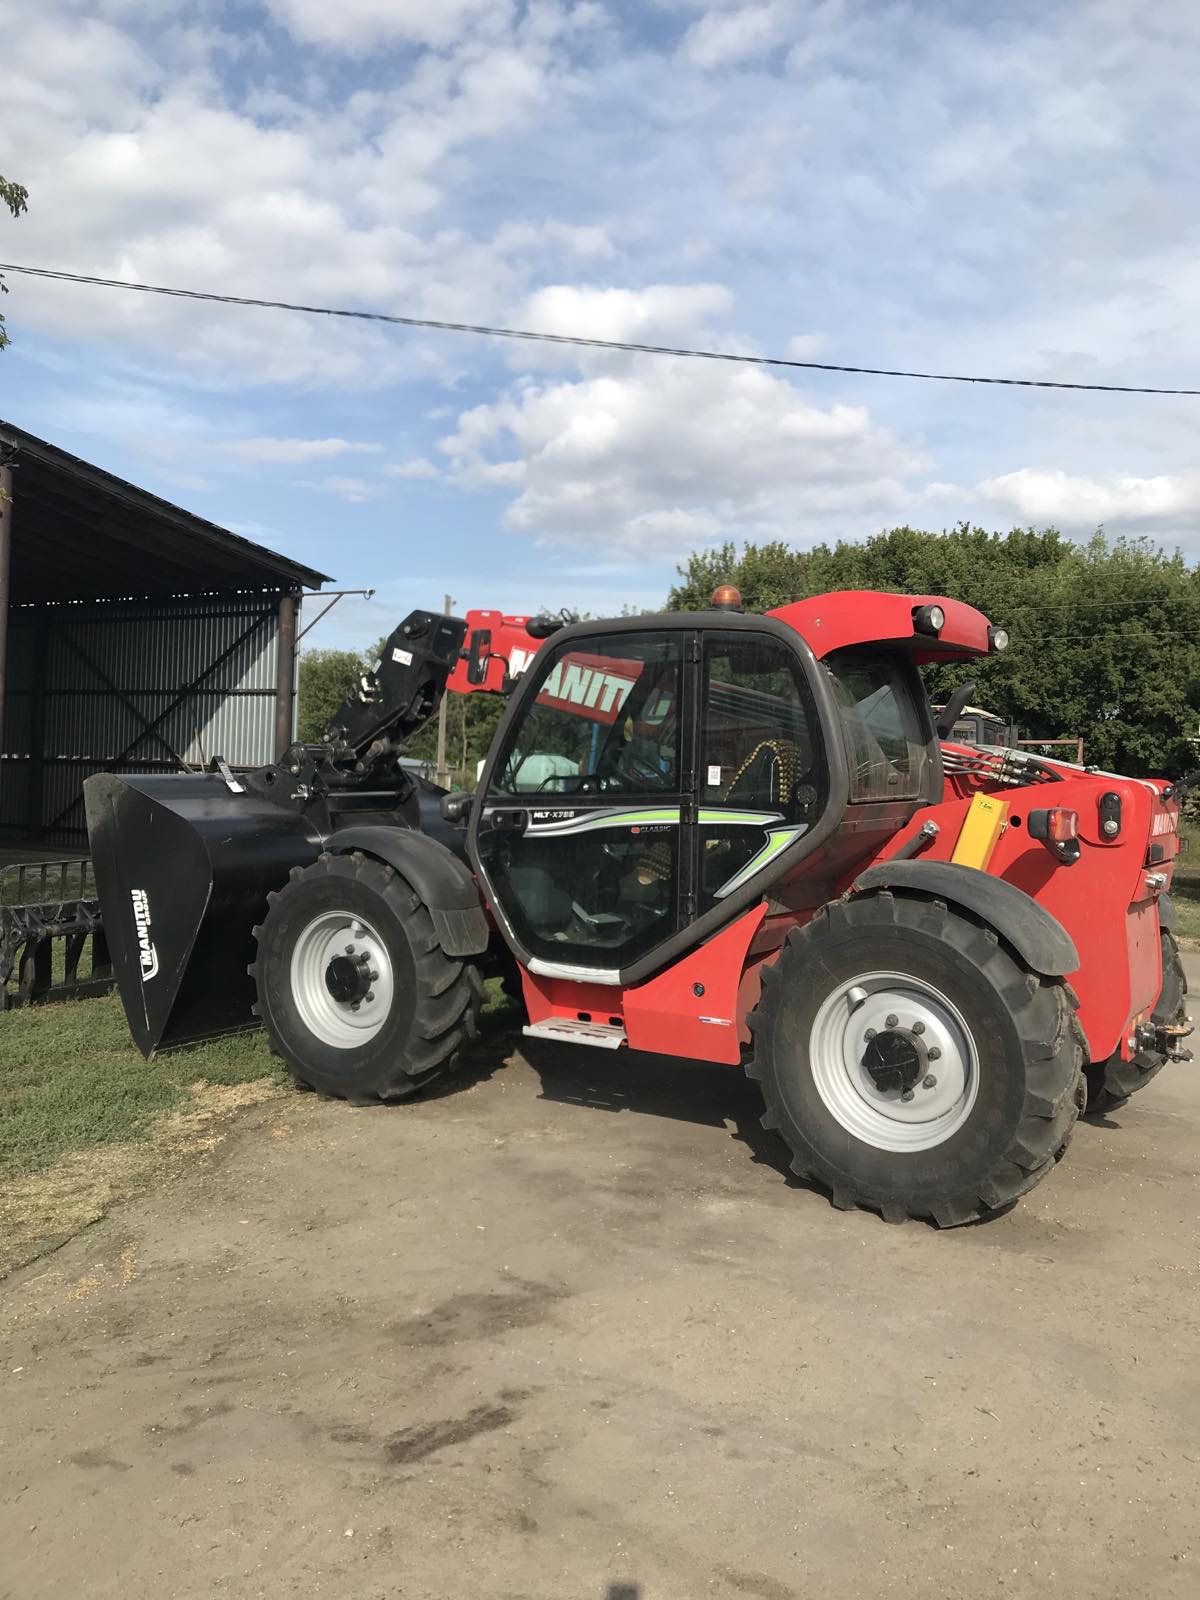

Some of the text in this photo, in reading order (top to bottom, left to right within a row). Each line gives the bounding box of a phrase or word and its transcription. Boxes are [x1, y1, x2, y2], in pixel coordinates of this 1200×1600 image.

[508, 647, 674, 726] MANITU
[131, 889, 153, 966] MANITOU
[141, 889, 151, 926] GROUP
